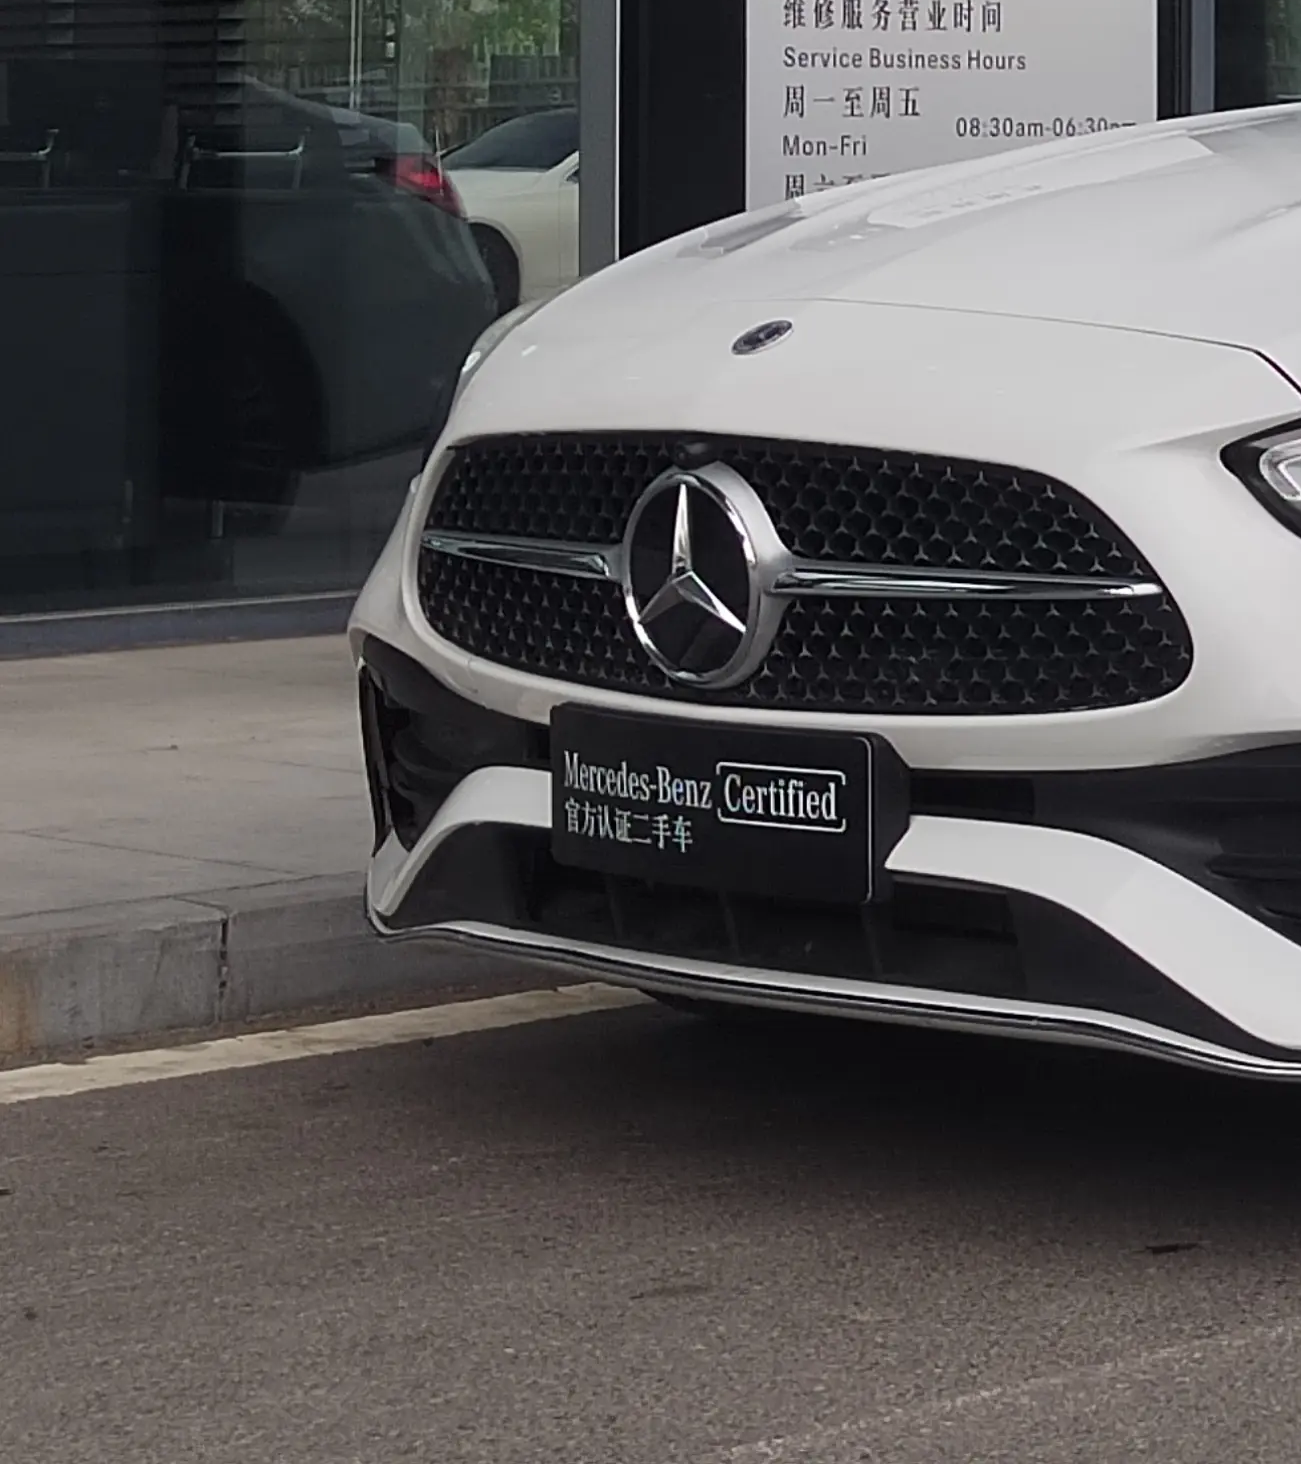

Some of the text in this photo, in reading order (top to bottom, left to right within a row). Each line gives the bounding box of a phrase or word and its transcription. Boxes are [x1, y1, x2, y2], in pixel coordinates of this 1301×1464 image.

[783, 47, 1026, 70] Service Business Hours
[783, 85, 920, 119] 周一至周五
[955, 117, 1137, 137] 08:30am-06:30
[782, 135, 867, 156] Mon-Fri
[564, 751, 837, 821] Mercedes-Benz Certified
[564, 797, 693, 853] 官方认证二手车
